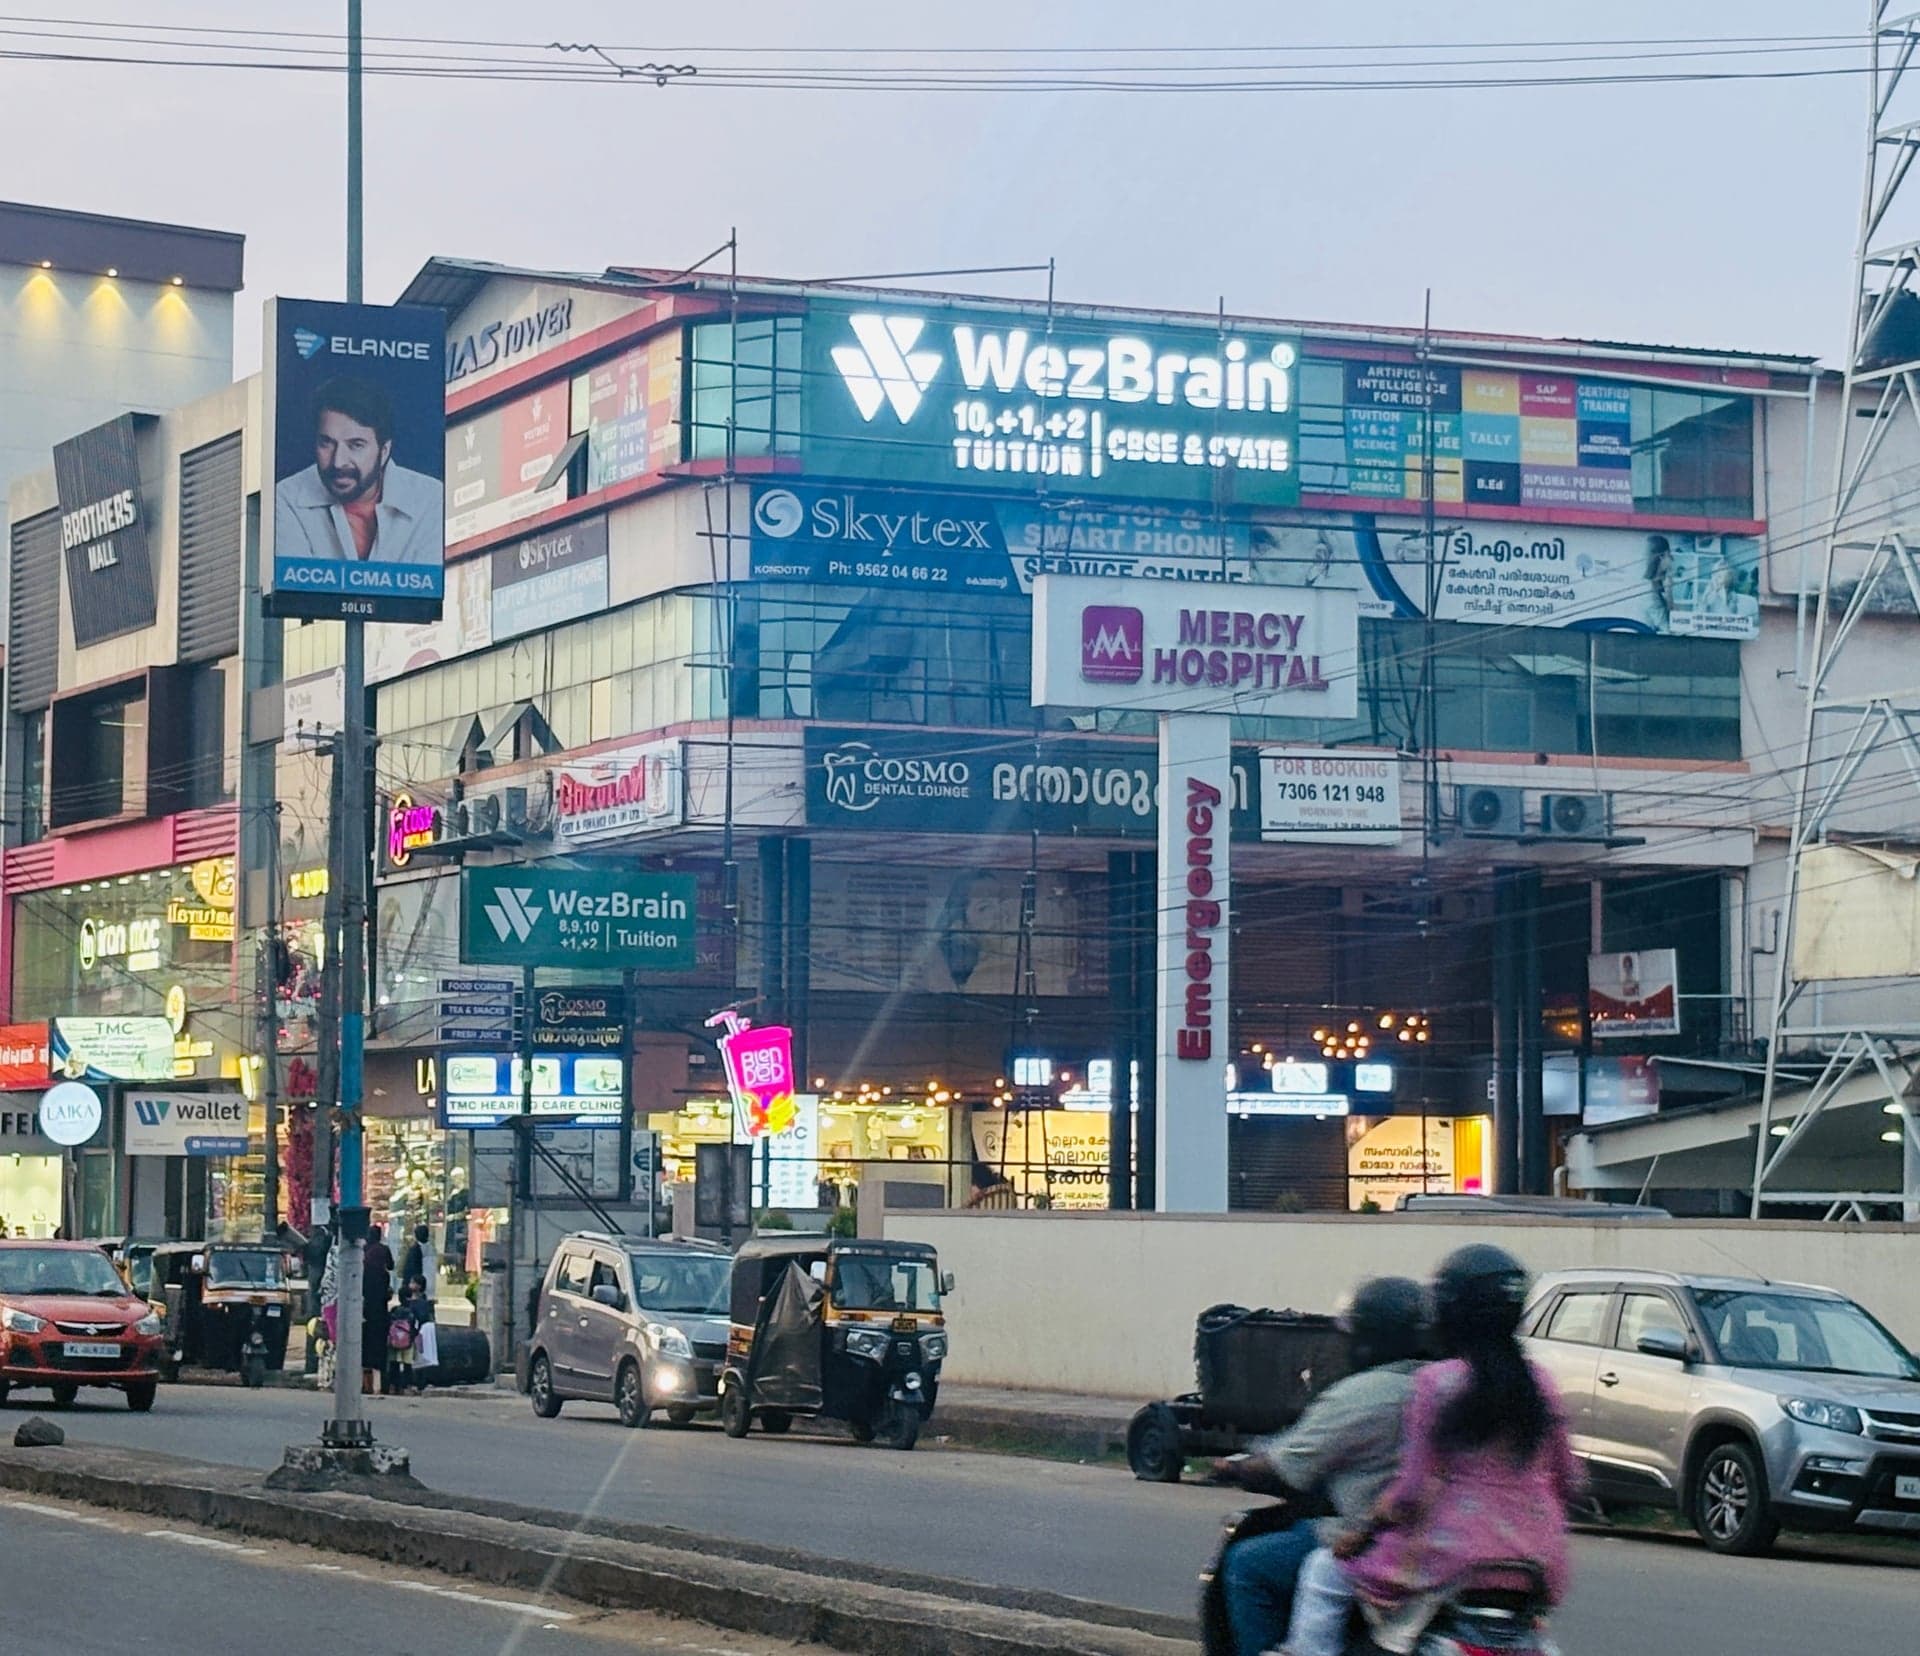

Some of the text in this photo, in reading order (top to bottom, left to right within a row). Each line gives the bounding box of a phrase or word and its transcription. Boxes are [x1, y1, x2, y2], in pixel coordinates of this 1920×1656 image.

[504, 299, 573, 357] TOWER
[331, 336, 430, 360] ELANCE
[953, 327, 1290, 412] WezBrain
[1357, 379, 1447, 394] INTELLIGECE
[1536, 385, 1558, 394] SAP
[1578, 385, 1629, 399] CERTIFIED
[1374, 391, 1431, 405] FOR KIDS
[1583, 400, 1626, 413] TRAINER
[953, 401, 1086, 440] 10,+1,+2
[1351, 410, 1400, 422] TUITION
[1352, 424, 1365, 435] +1
[1469, 432, 1512, 445] TALLY
[1436, 437, 1459, 449] JEE
[953, 439, 1082, 475] TUITION
[1477, 478, 1504, 490] B.Ed
[1523, 474, 1566, 486] DIPLOMA
[1588, 479, 1630, 491] DIPLOMA
[1522, 488, 1533, 499] IN
[1535, 489, 1577, 501] FASHION
[63, 489, 136, 550] BROTHERS
[811, 495, 992, 556] Skytex
[1024, 523, 1235, 557] SMART PHONE
[88, 540, 118, 571] MALL
[530, 534, 573, 571] Skytex
[284, 568, 434, 589] ACCA CMA USA
[829, 561, 852, 575] Ph:
[856, 563, 888, 578] 9562
[892, 567, 908, 579] 04
[911, 568, 928, 581] 66
[931, 570, 948, 582] 22
[341, 602, 373, 614] SOLUS
[1178, 609, 1304, 650] MERCY
[1152, 648, 1329, 691] HOSPITAL
[864, 758, 969, 784] COSMO
[1273, 760, 1388, 778] FOR BOOKING
[559, 755, 645, 816] GOKULAM
[864, 783, 969, 798] DENTAL LOUNGE
[1278, 783, 1384, 802] 7306 121 948
[548, 889, 686, 919] WezBrain
[559, 919, 599, 935] 8,9,10
[1178, 776, 1221, 1060] Emergency
[560, 929, 677, 951] +1,+2 Tuition
[448, 982, 473, 991] FOOD
[450, 1006, 463, 1015] TEA
[558, 1000, 606, 1011] COSMO
[95, 1023, 133, 1034] TMC
[452, 1030, 476, 1039] FRESH
[47, 1103, 95, 1121] LAIKA
[177, 1102, 241, 1120] wallet
[450, 1102, 476, 1110] TMC
[542, 1102, 575, 1111] CARE
[580, 1102, 622, 1111] CLINIC
